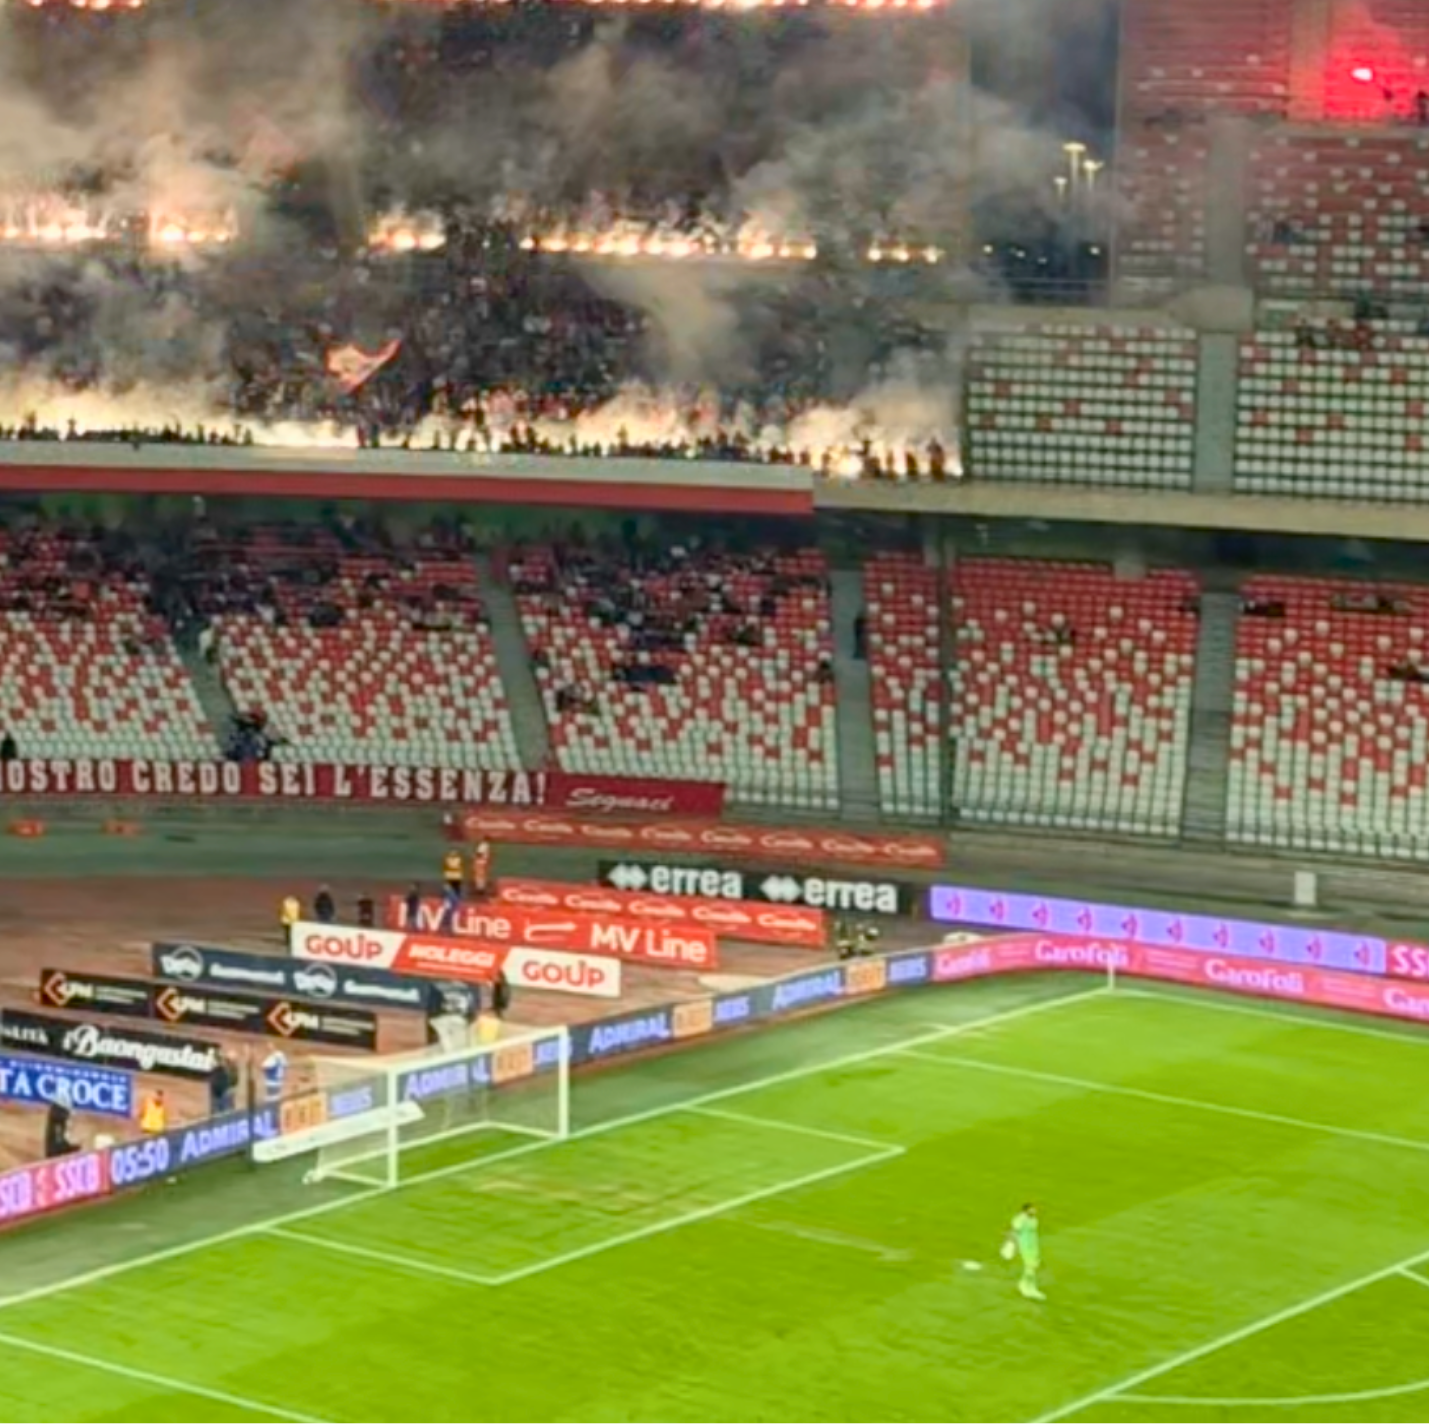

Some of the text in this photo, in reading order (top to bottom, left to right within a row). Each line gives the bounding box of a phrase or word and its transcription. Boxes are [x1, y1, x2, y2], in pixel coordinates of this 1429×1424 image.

[131, 760, 240, 794] CREDO
[258, 762, 316, 796] SEI
[334, 766, 547, 805] L'ESSENZA!
[452, 907, 511, 939] Line
[592, 924, 640, 954] MV
[646, 928, 708, 963] Line
[304, 934, 383, 960] GOUP
[521, 959, 605, 988] GOUP
[1034, 939, 1129, 968] Garofoli
[1203, 957, 1305, 995] Garofoli
[36, 1071, 129, 1115] CROCE
[109, 1139, 169, 1185] 05:50
